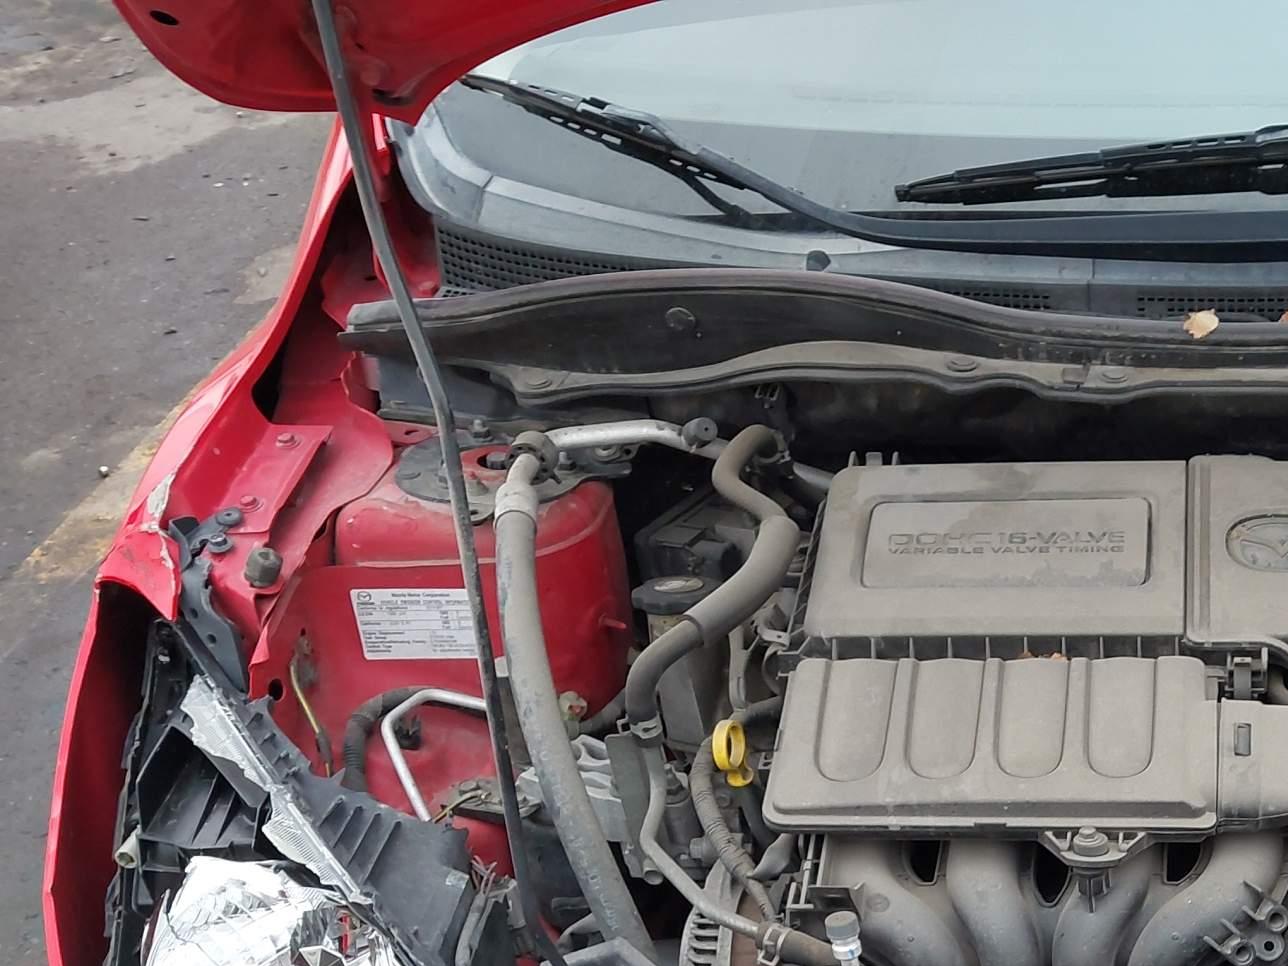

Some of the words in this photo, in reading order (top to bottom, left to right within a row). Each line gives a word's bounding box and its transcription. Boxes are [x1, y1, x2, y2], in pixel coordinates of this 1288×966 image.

[888, 546, 985, 554] VARIABLE
[991, 546, 1051, 554] VALVE
[1056, 545, 1125, 553] TIMING
